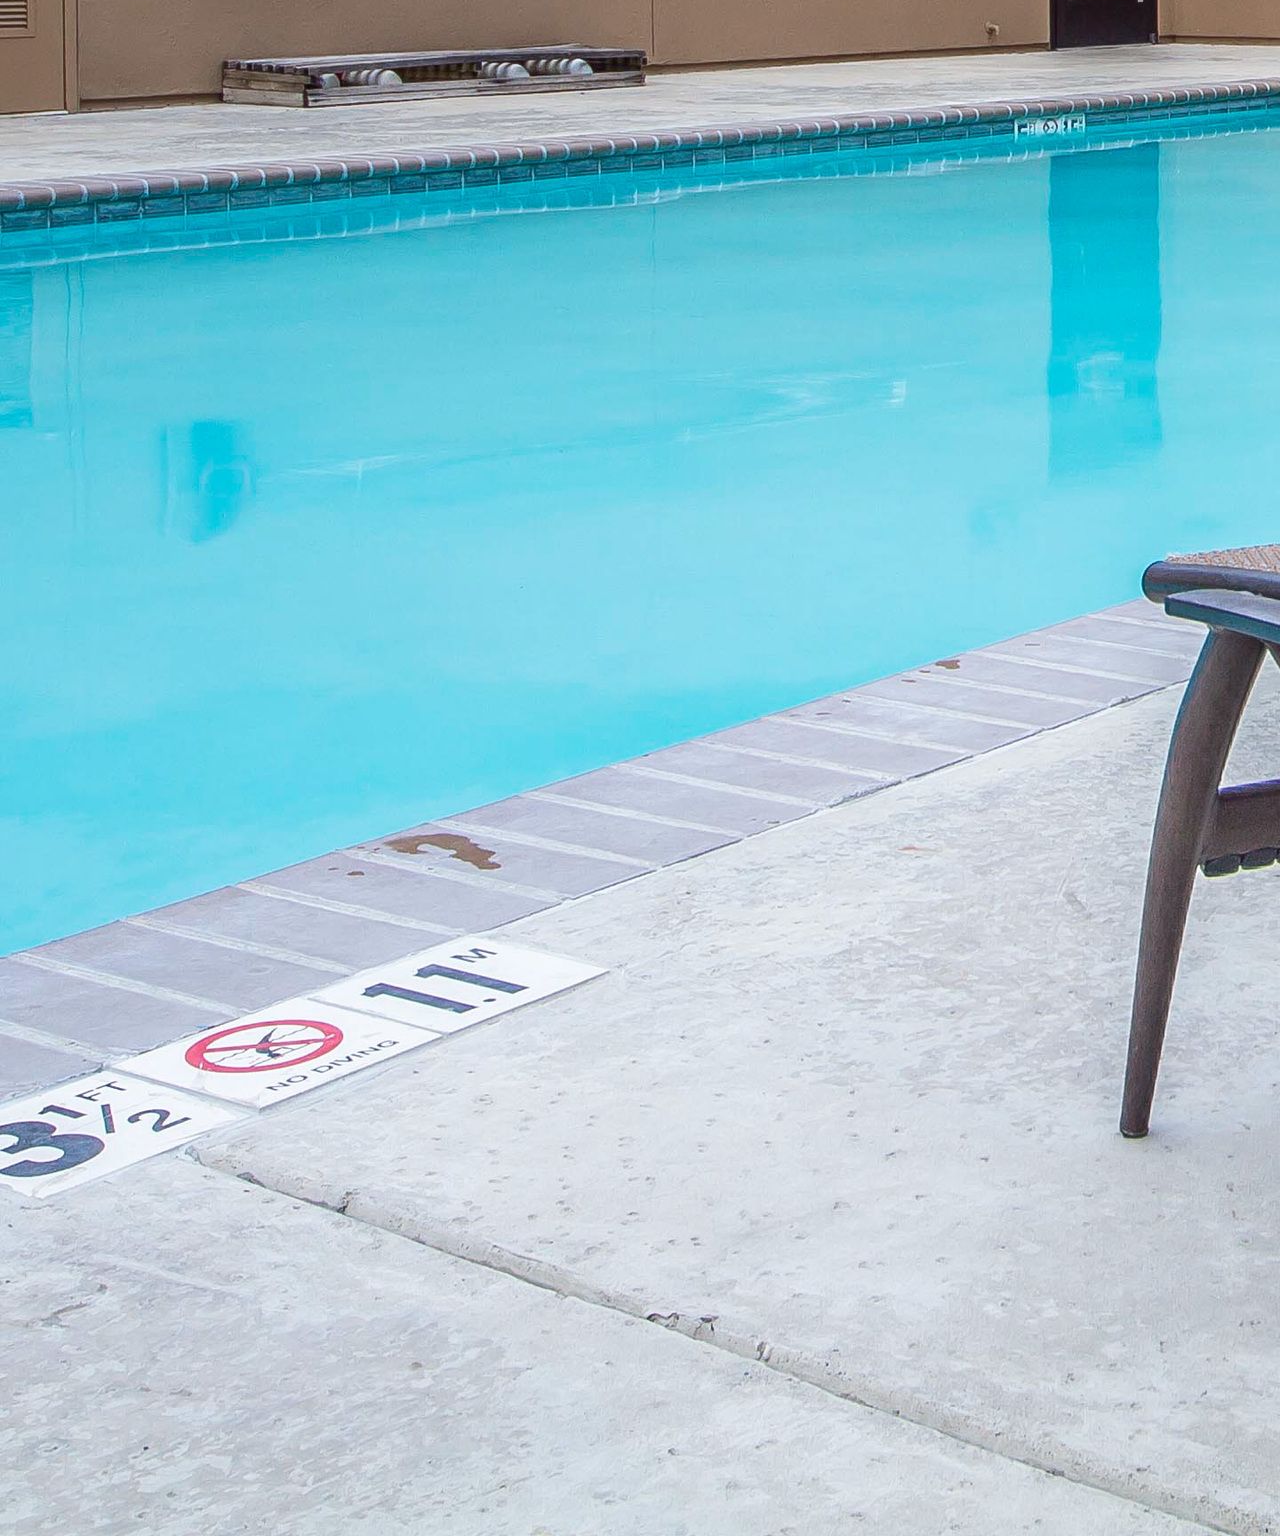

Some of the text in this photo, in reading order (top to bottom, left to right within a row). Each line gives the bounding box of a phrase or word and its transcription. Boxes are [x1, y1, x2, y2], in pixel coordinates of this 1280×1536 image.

[449, 947, 498, 963] M
[265, 1039, 400, 1091] NO DIVING
[75, 1080, 127, 1102] FT
